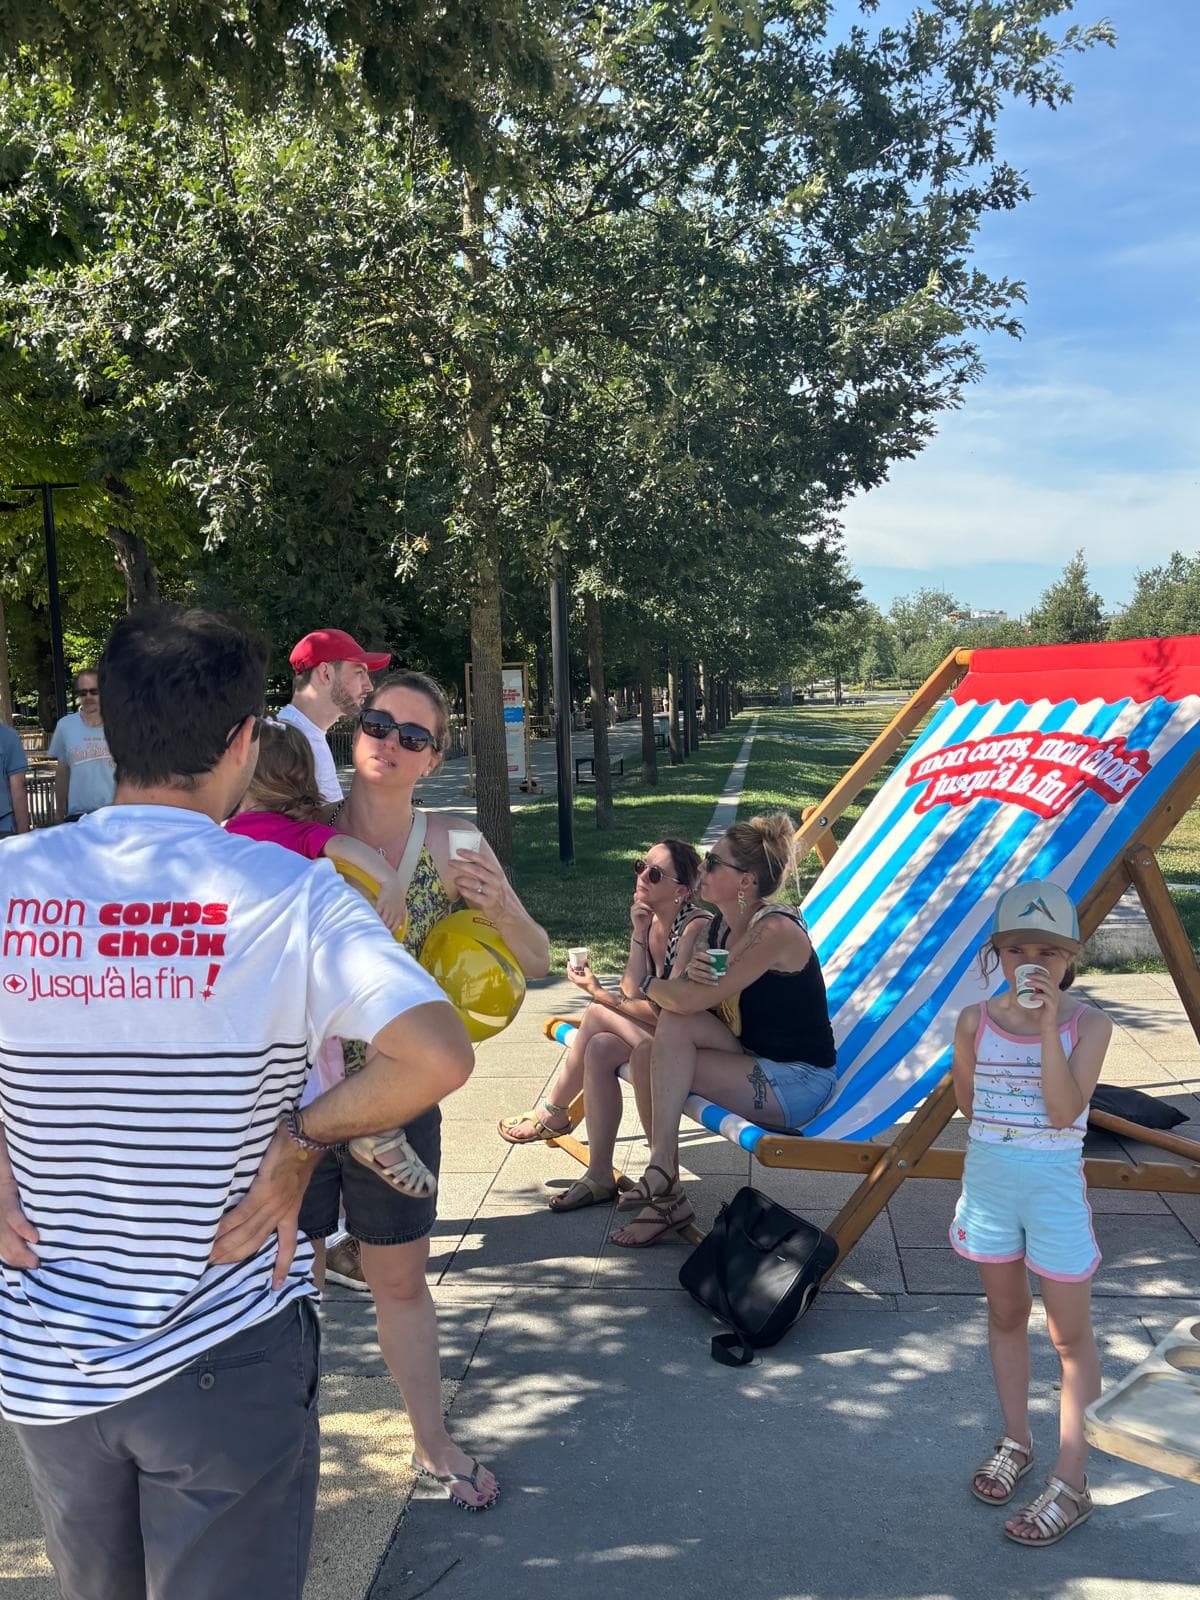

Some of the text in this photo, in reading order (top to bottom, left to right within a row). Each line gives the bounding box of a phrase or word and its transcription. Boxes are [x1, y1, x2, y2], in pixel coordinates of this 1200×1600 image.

[917, 748, 968, 778] mon
[1031, 738, 1089, 765] mon
[1078, 743, 1144, 793] choix
[1006, 764, 1037, 794] la
[6, 898, 229, 927] mon corps
[2, 929, 226, 958] mon choix
[130, 966, 152, 999] la
